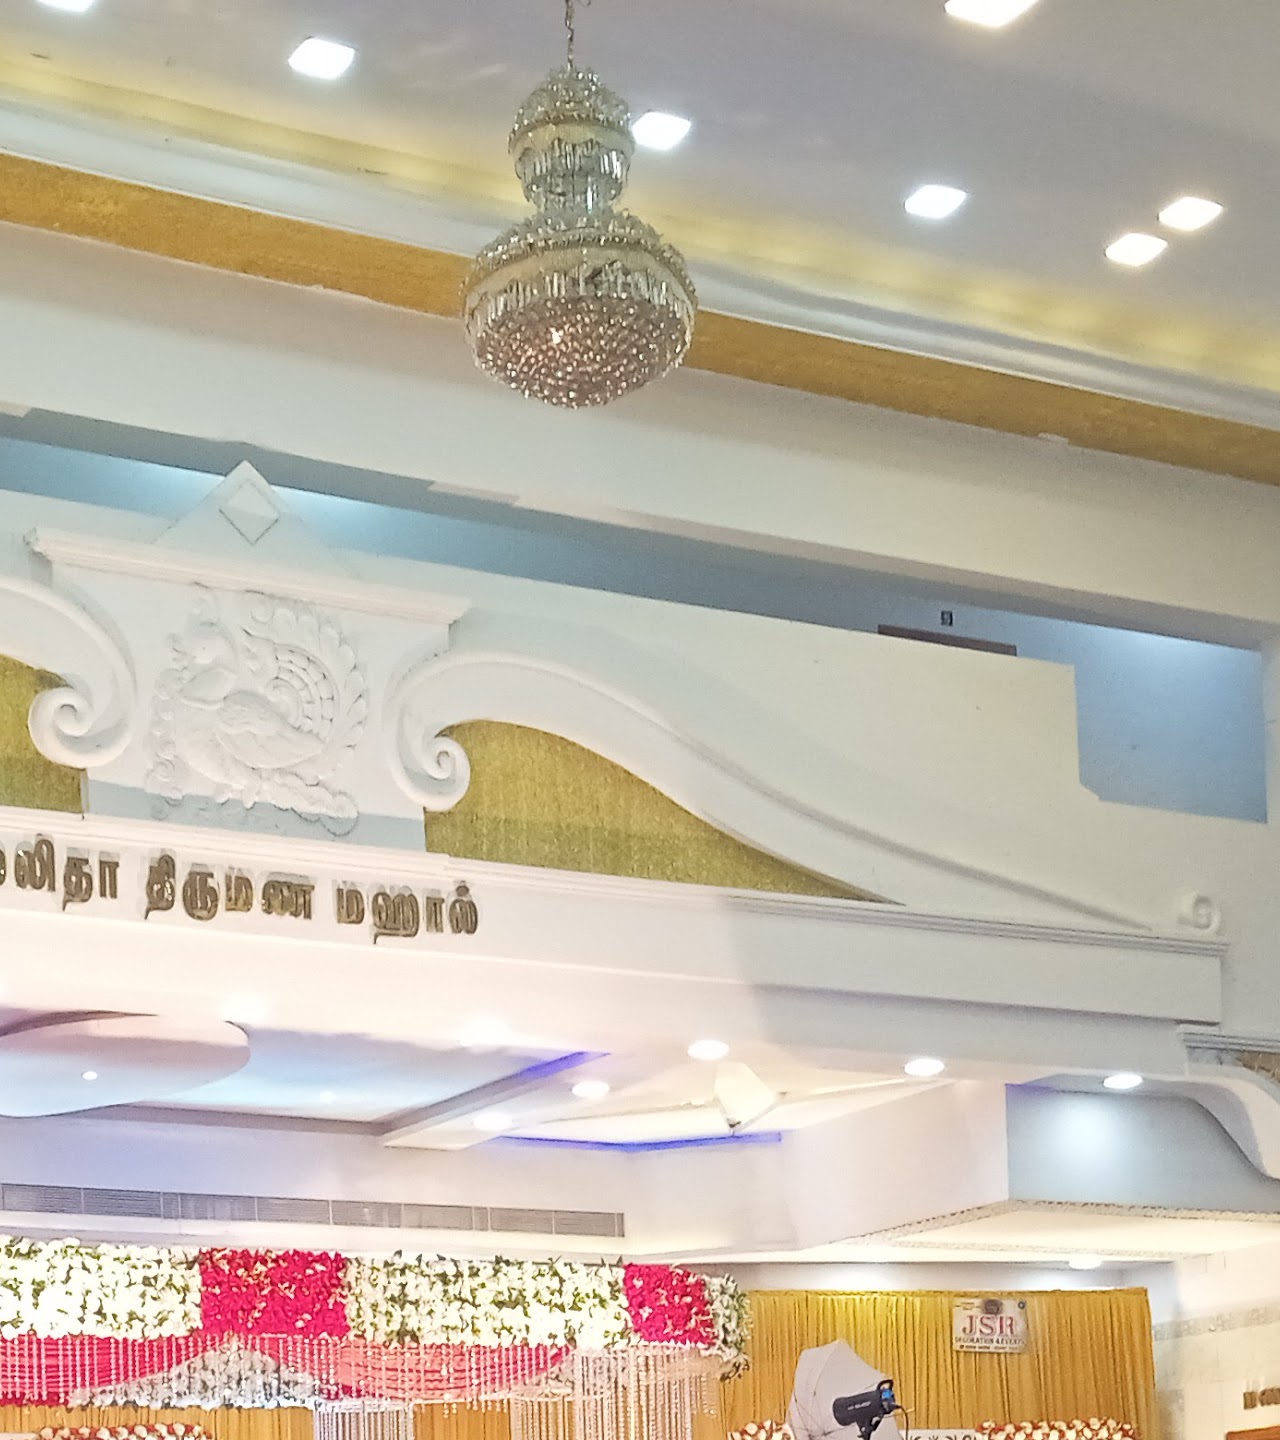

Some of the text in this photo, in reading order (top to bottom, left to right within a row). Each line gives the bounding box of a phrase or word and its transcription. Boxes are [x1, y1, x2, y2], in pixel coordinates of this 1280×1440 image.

[144, 854, 315, 921] திருமண
[336, 884, 478, 944] மஹால்
[962, 1315, 1017, 1337] JSR
